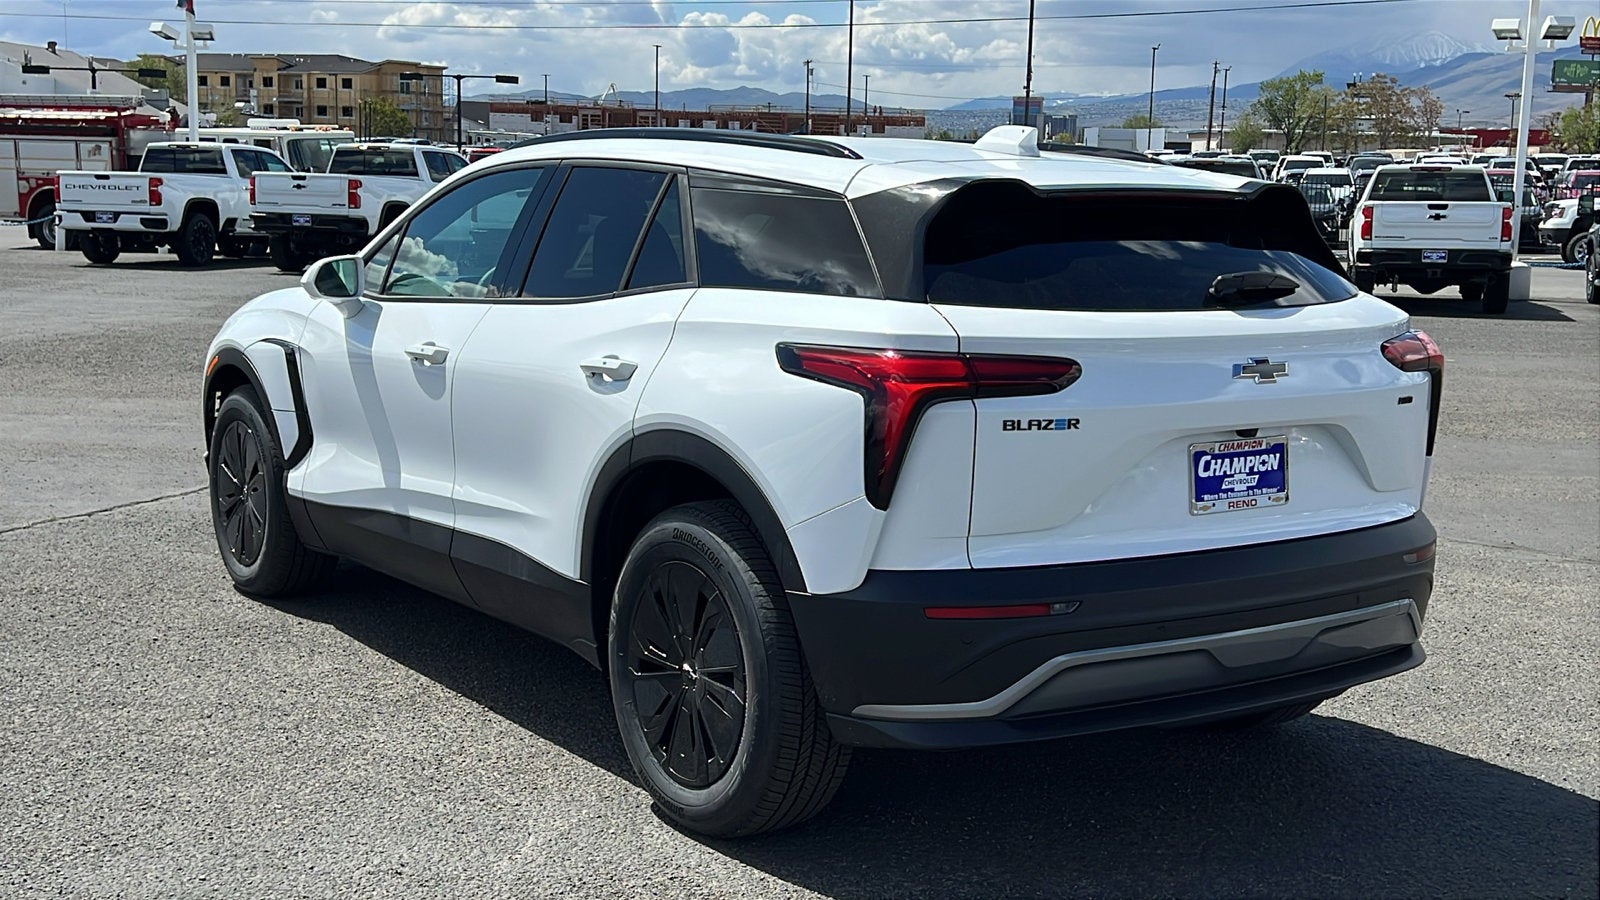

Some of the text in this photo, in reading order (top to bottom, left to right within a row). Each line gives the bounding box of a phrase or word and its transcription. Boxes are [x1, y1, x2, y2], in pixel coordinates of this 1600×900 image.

[65, 183, 142, 192] CHEVROLET
[1002, 417, 1081, 432] BLAZER
[1218, 440, 1263, 452] CHAMPION
[1198, 453, 1279, 477] CHAMPION
[1224, 477, 1256, 486] CHEVROLET
[1228, 499, 1257, 509] RENO
[672, 527, 725, 570] BRIDGESTONE
